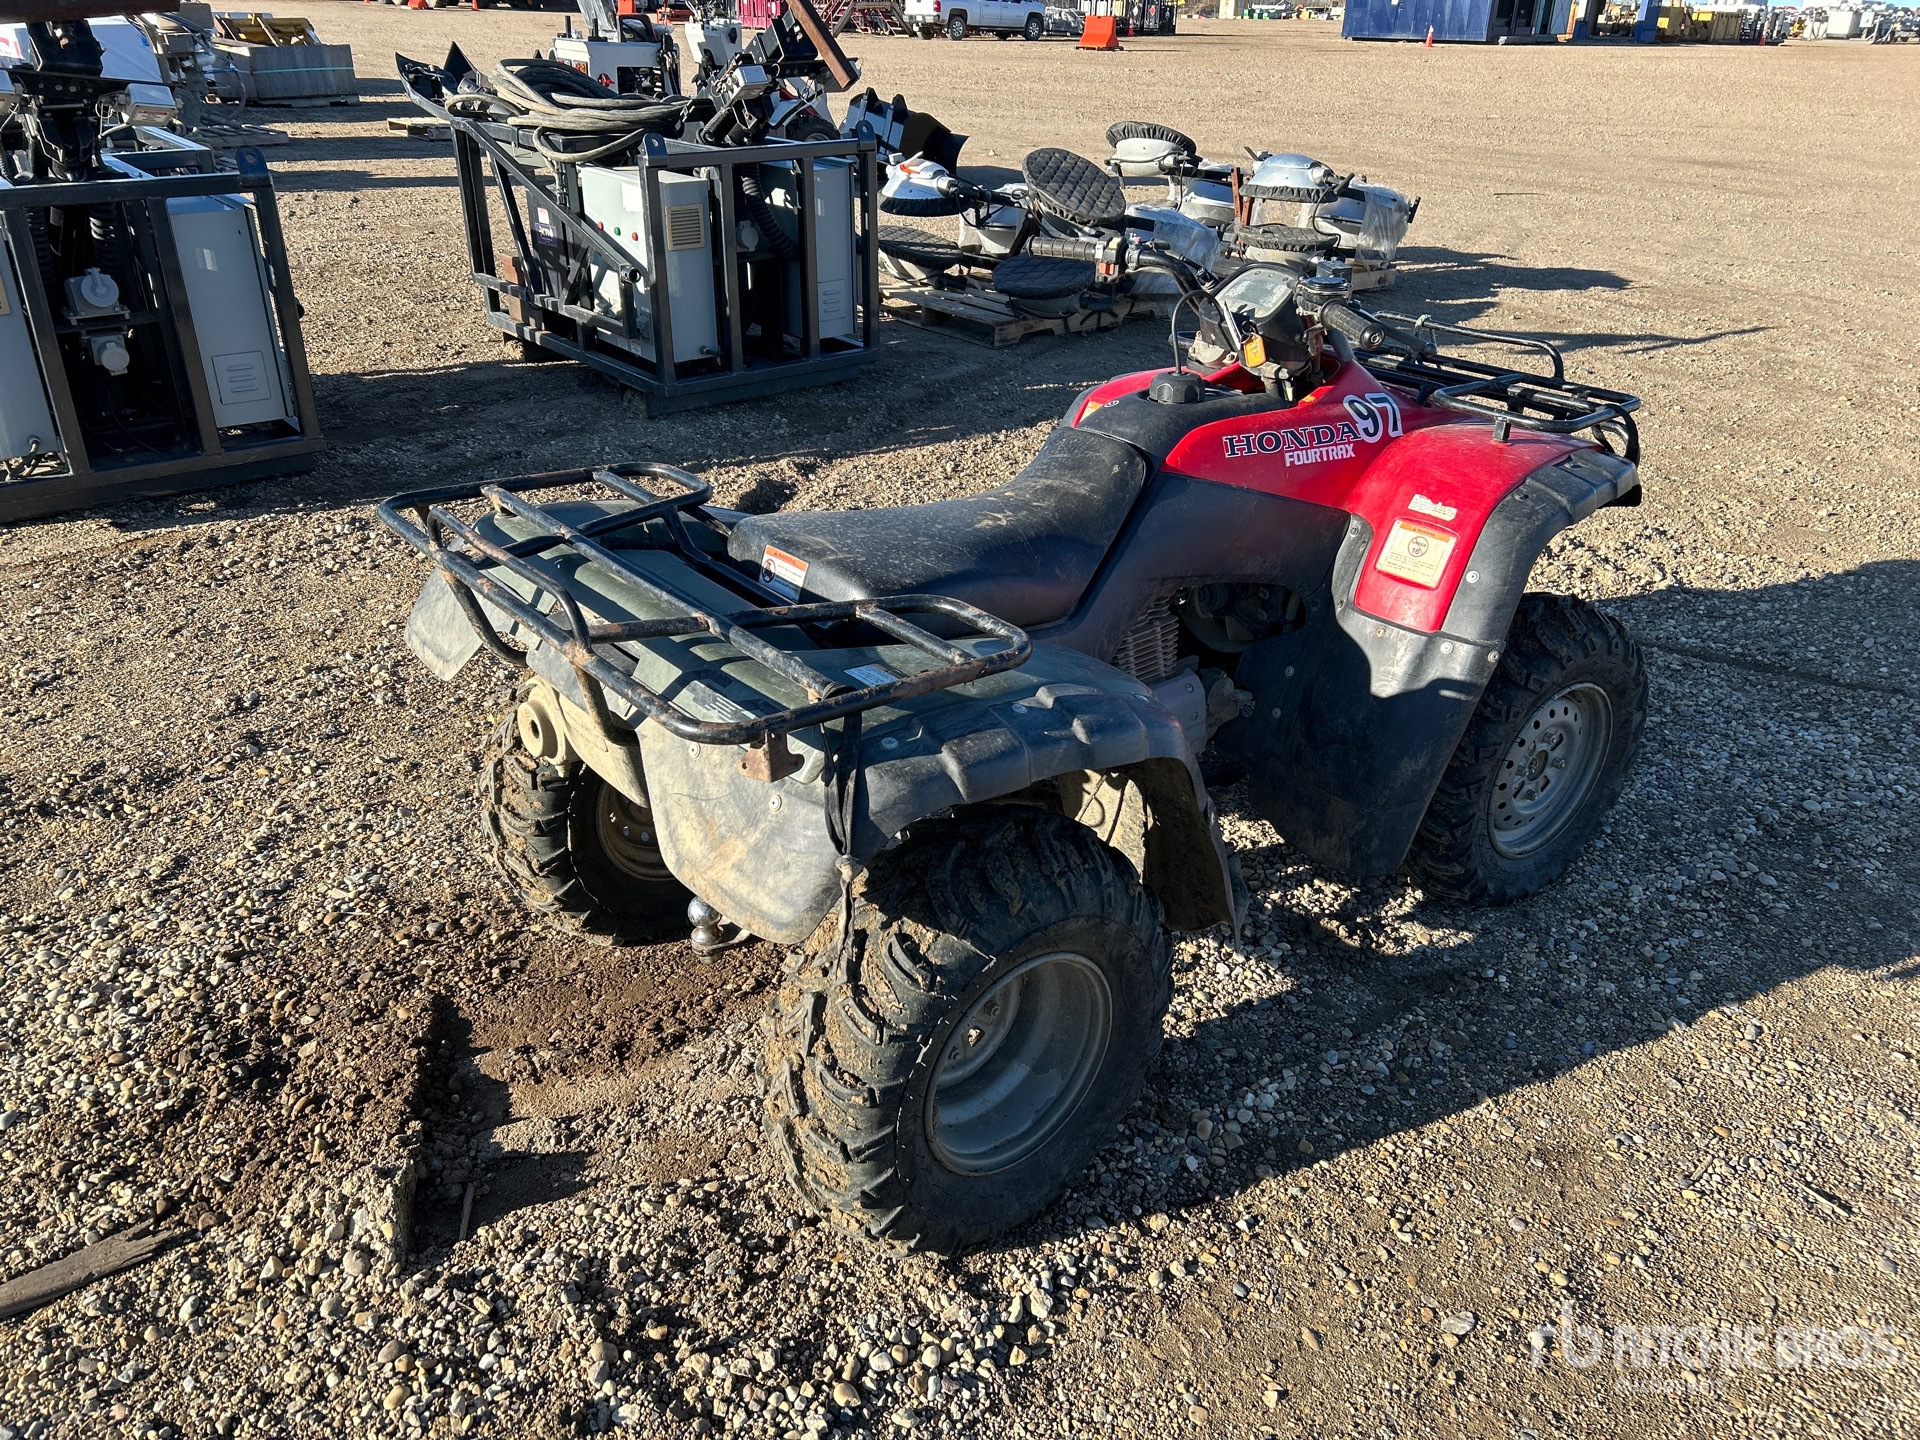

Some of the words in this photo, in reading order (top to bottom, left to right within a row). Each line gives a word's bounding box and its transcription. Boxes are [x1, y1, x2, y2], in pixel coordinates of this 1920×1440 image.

[1343, 392, 1403, 443] 97
[1223, 422, 1362, 457] HONDA
[1284, 443, 1356, 467] FOURTRAX
[1412, 547, 1420, 555] 16
